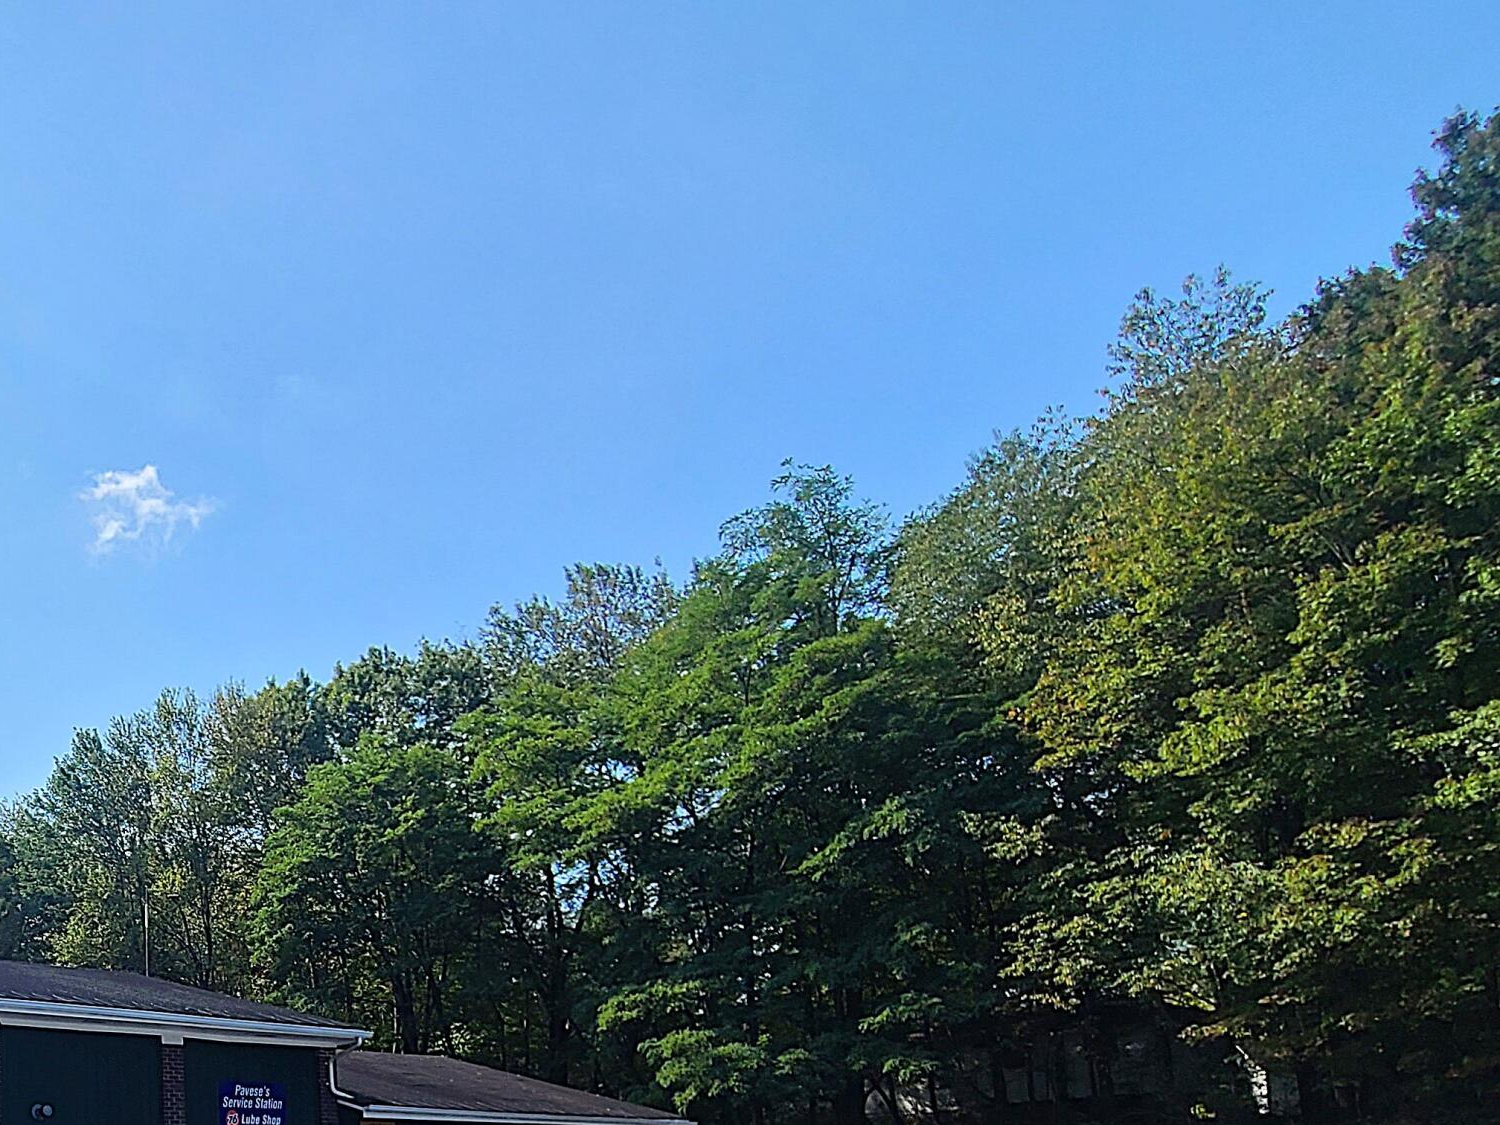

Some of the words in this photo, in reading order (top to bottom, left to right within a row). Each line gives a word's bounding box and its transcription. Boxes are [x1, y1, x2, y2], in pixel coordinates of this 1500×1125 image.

[235, 1085, 270, 1097] Pavese's
[223, 1096, 253, 1109] Service
[255, 1098, 283, 1110] Station
[227, 1113, 240, 1125] 76
[241, 1114, 260, 1125] Lube
